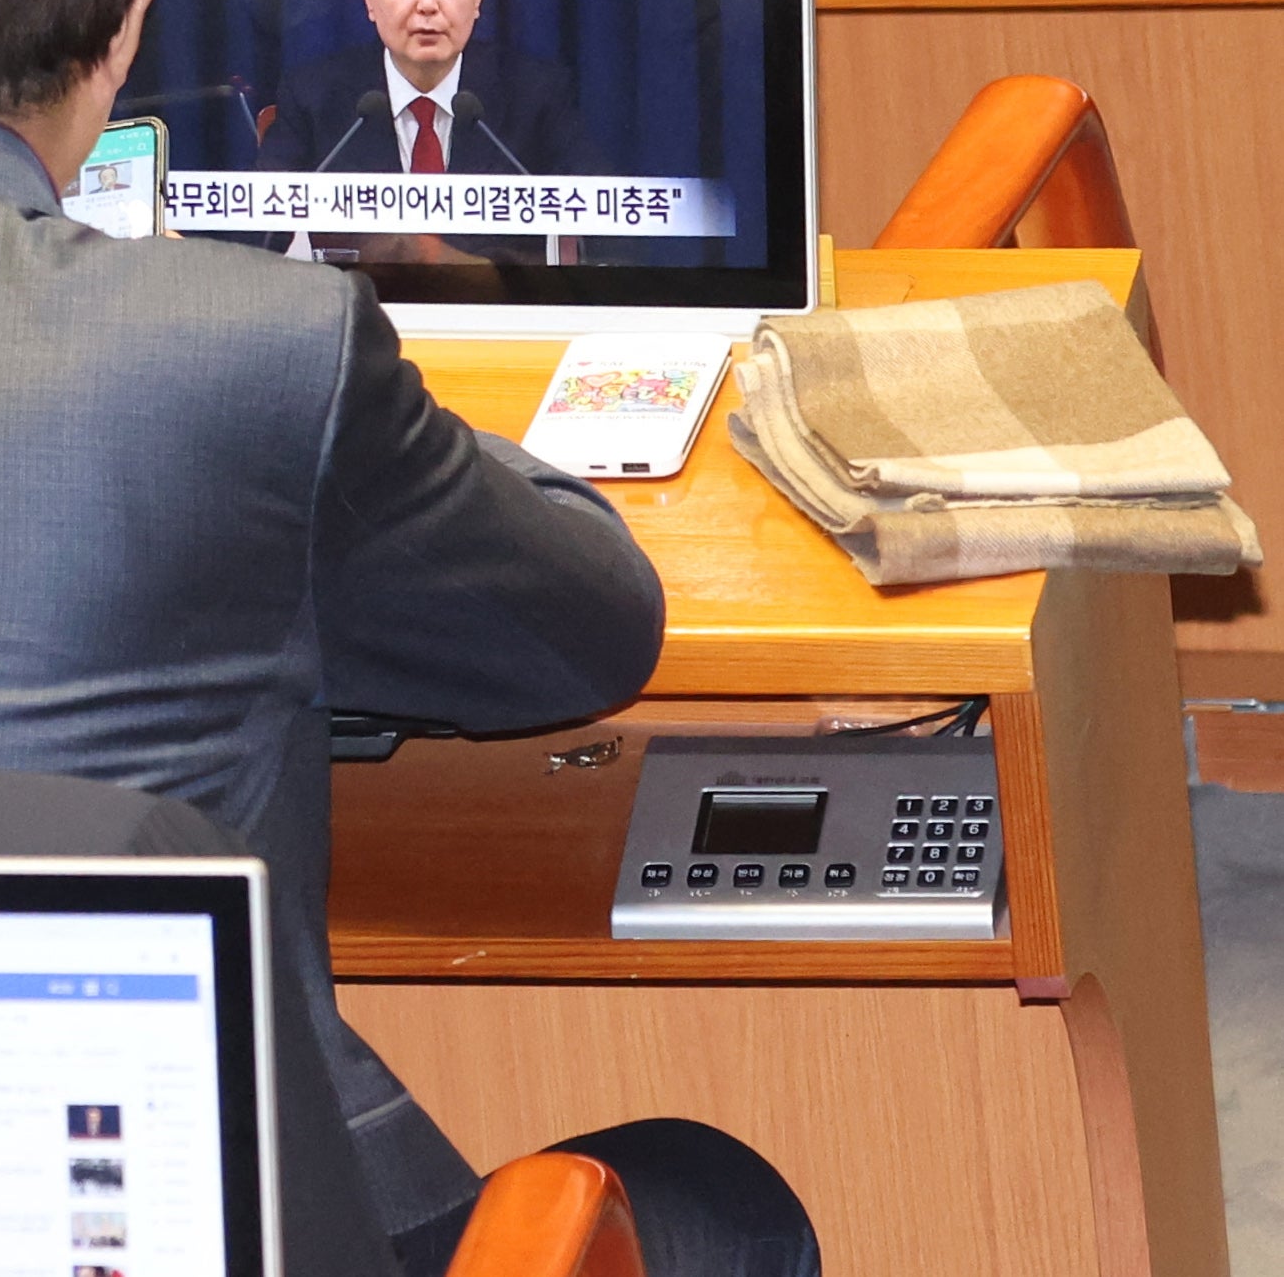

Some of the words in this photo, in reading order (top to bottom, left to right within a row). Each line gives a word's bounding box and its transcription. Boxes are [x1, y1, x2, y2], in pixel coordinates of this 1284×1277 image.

[463, 185, 588, 224] 의결정족수
[596, 186, 683, 226] 미충족"
[906, 801, 913, 812] 1
[938, 800, 950, 812] 2
[973, 800, 985, 812] 3
[898, 824, 910, 835] 4
[934, 824, 945, 836] 5
[968, 824, 980, 835] 6
[894, 848, 905, 860] 7
[929, 848, 941, 860] 8
[965, 847, 977, 859] 9
